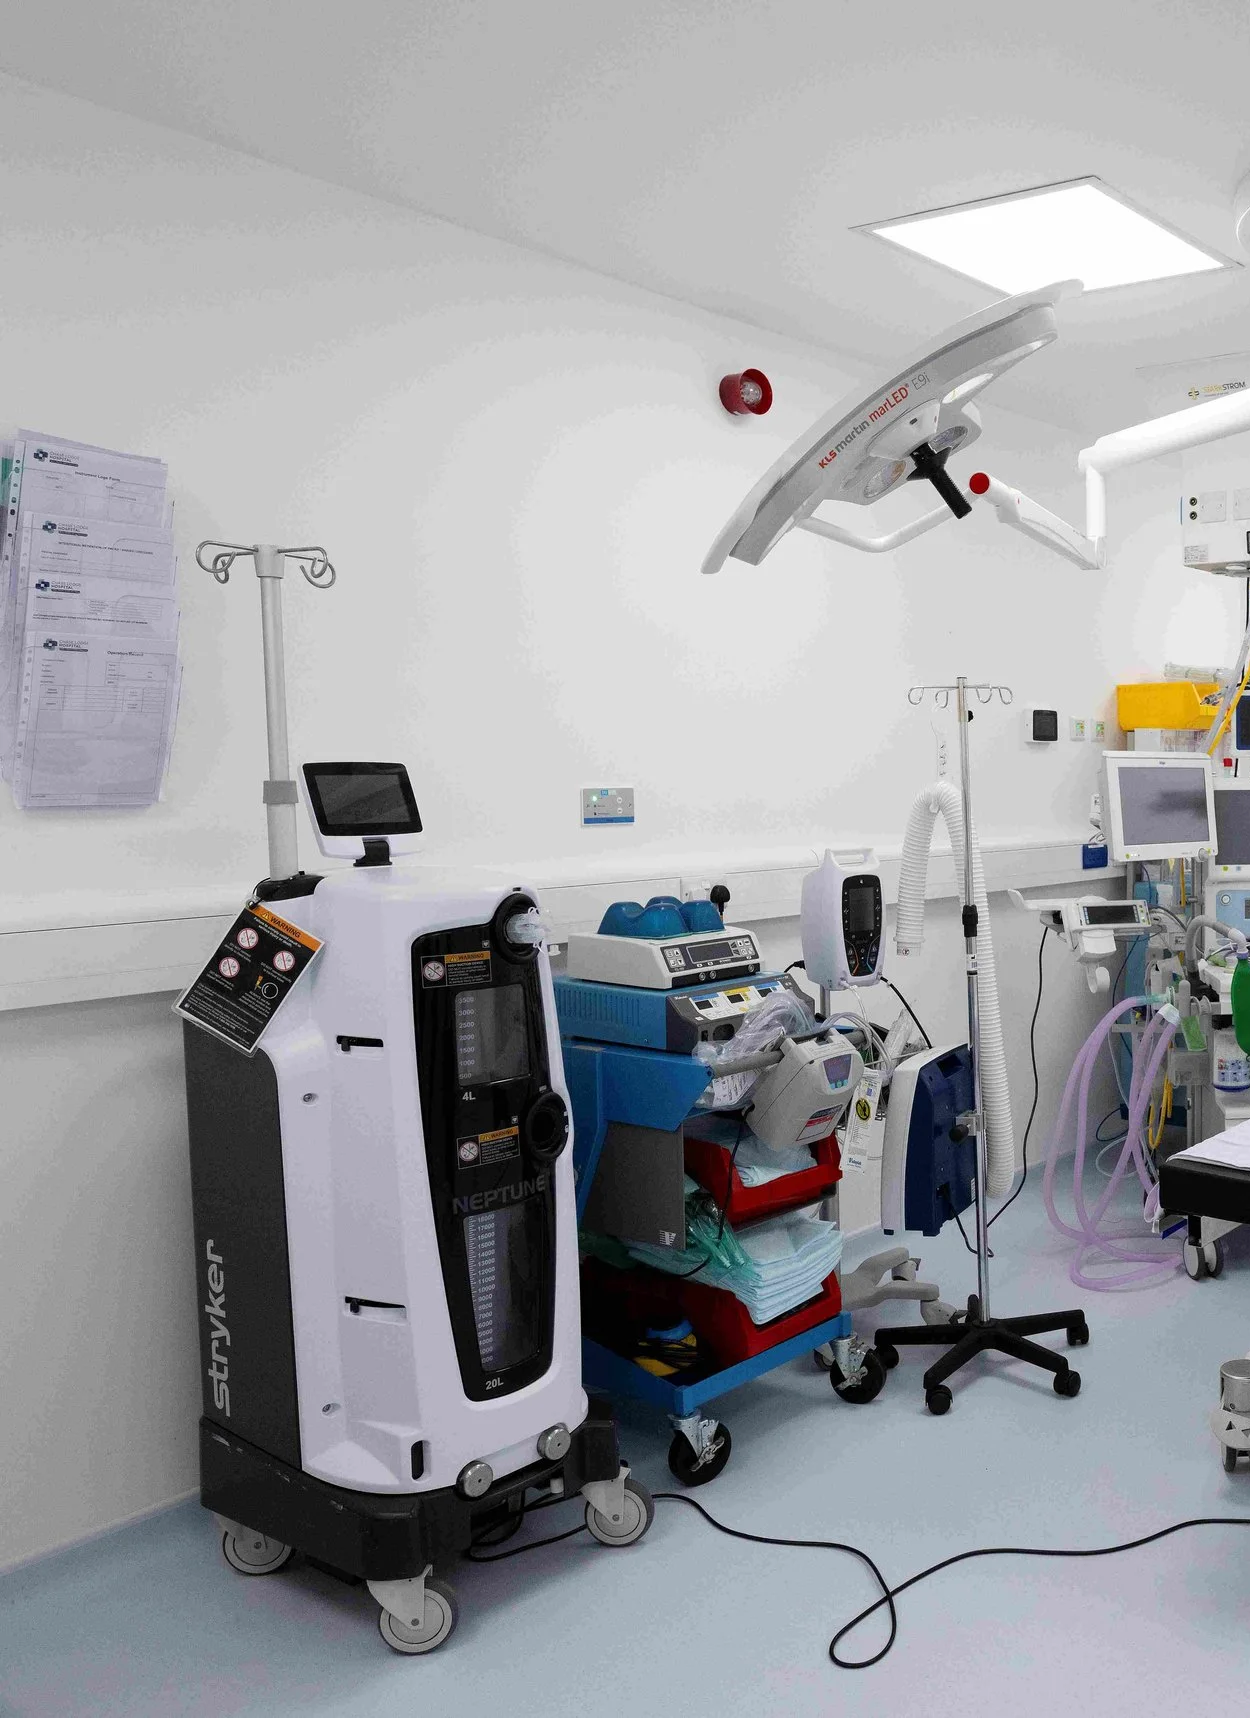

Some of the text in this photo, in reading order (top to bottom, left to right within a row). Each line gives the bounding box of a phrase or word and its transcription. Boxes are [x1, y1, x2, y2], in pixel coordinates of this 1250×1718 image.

[819, 450, 837, 469] KLS
[835, 420, 870, 453] martin
[911, 372, 931, 390] E9i
[270, 916, 301, 938] WARNING
[462, 1092, 476, 1100] 4L
[453, 1174, 545, 1215] NEPTUNE
[205, 1239, 230, 1417] stryker
[485, 1377, 504, 1391] 20L
